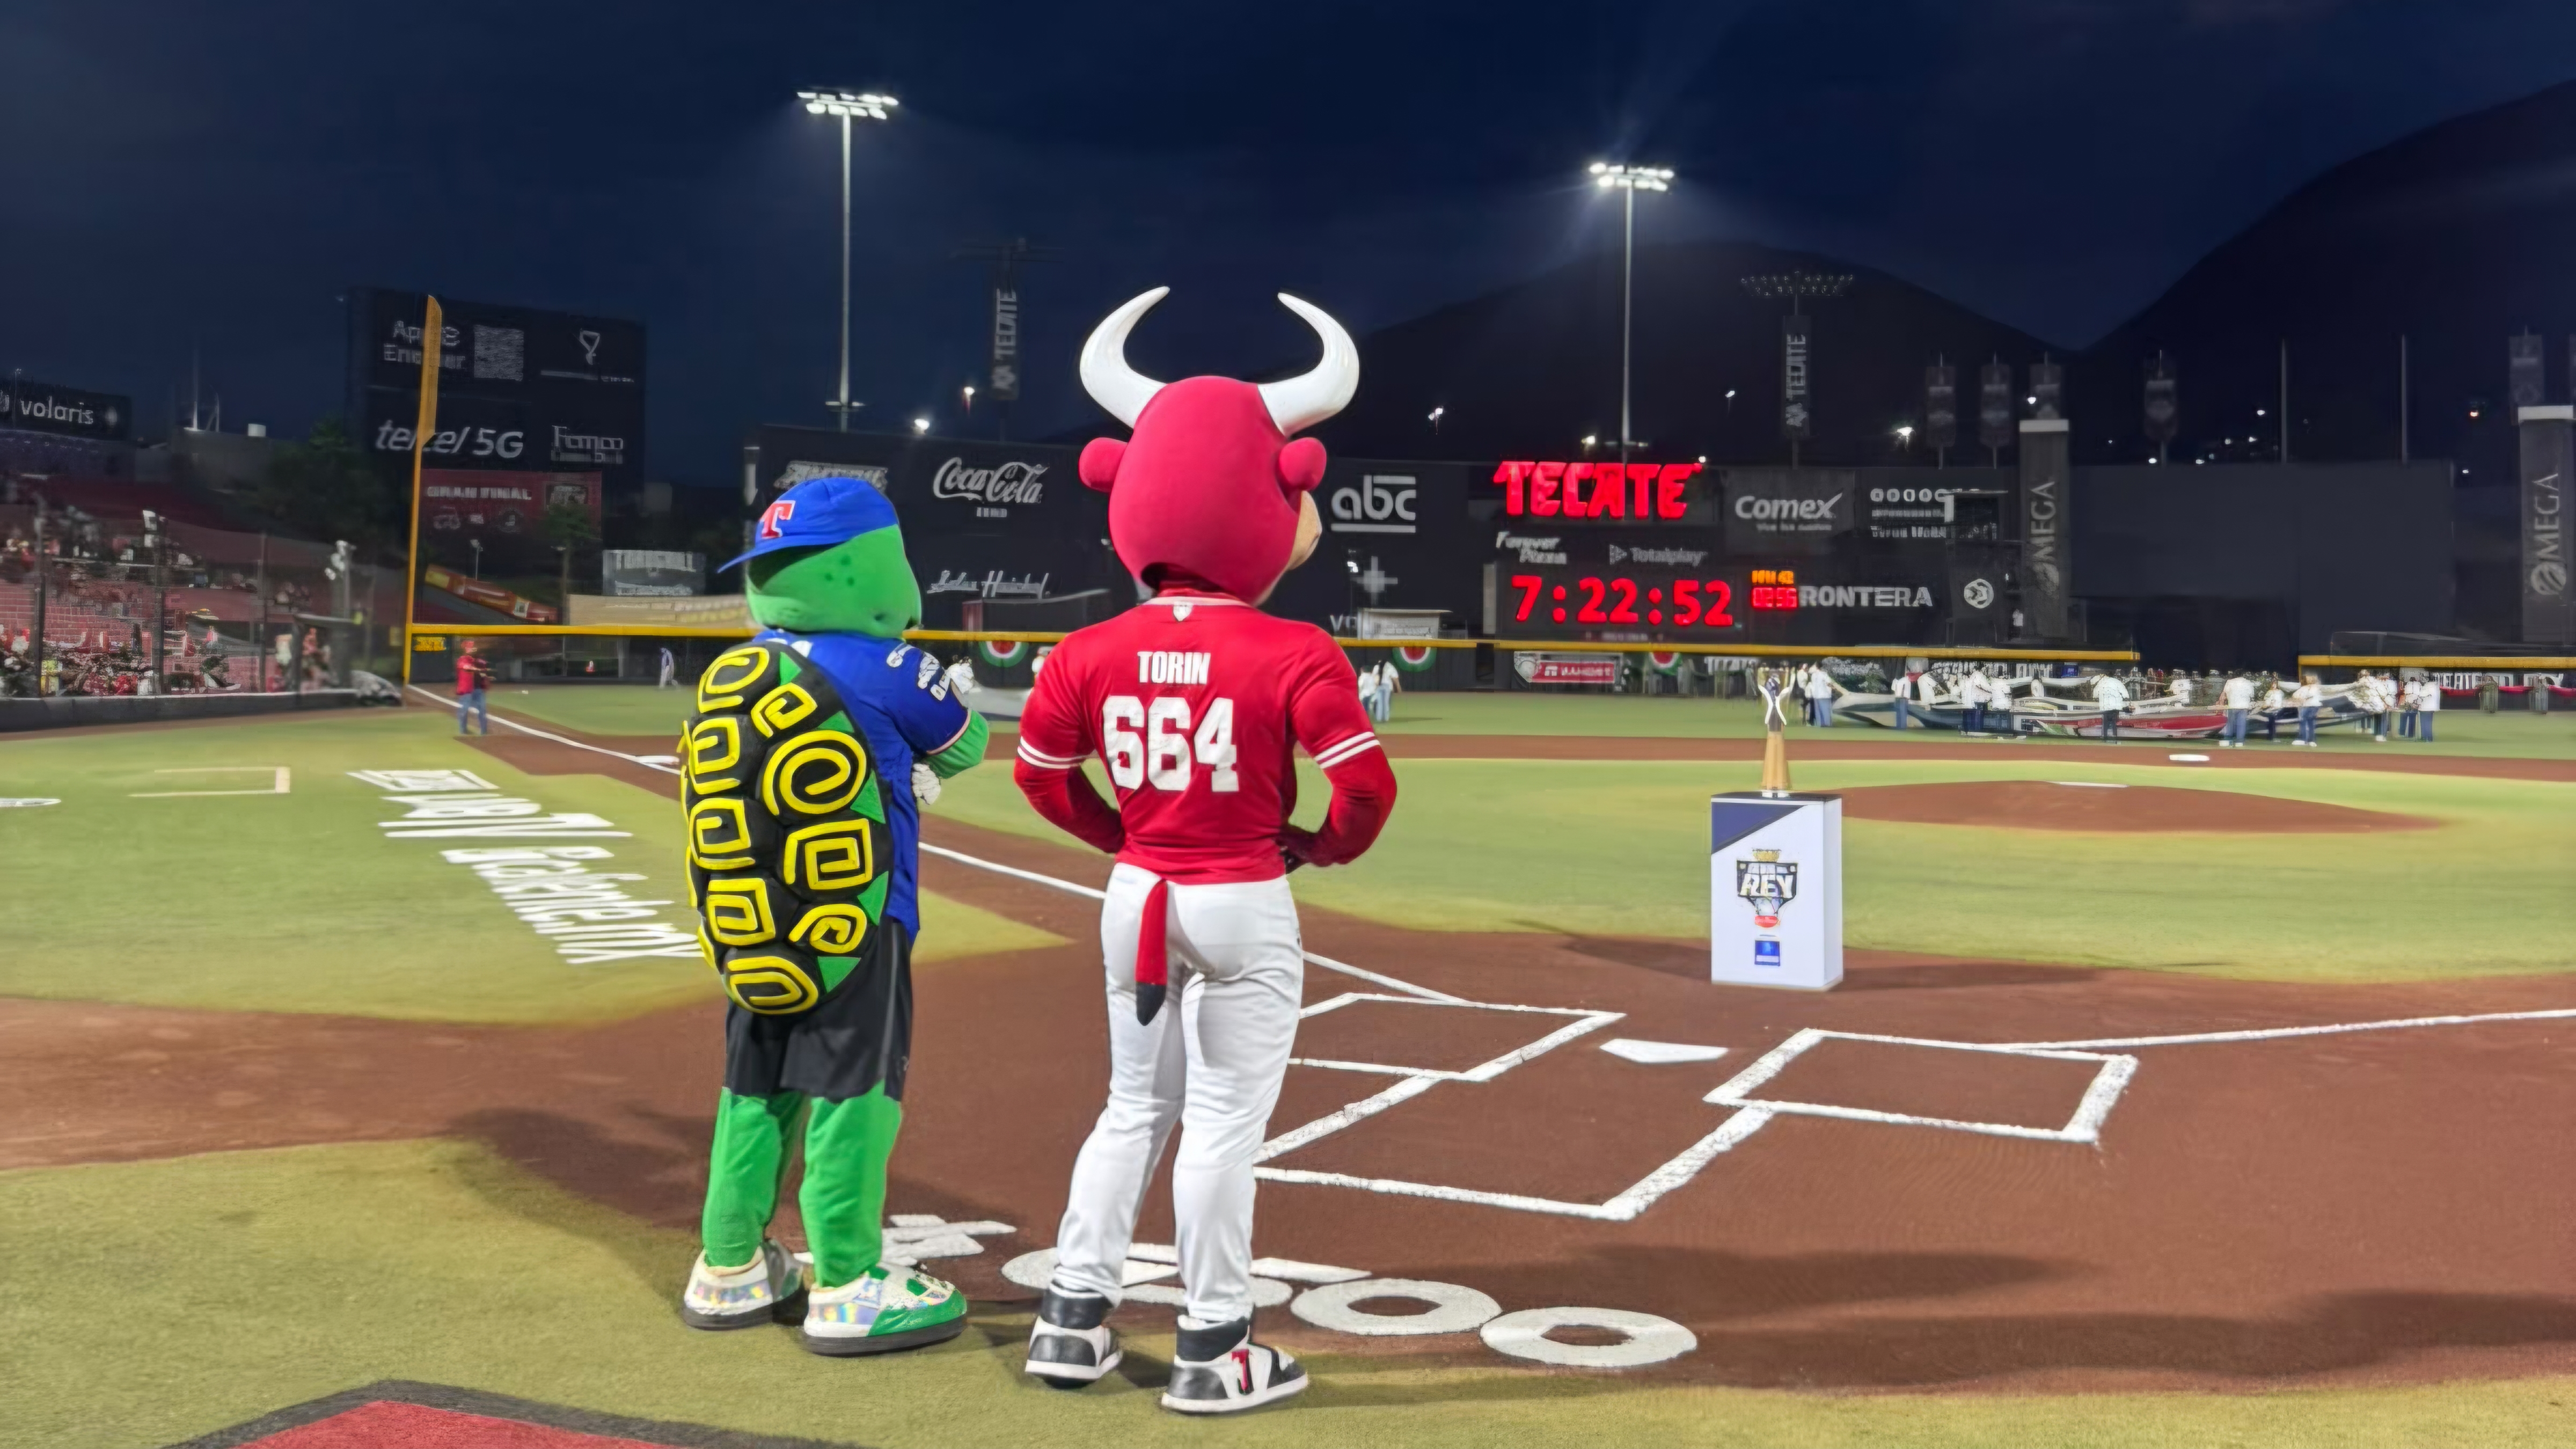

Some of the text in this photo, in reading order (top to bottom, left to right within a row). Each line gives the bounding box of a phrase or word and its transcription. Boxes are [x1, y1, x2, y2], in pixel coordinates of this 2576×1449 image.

[20, 395, 94, 425] volaris
[472, 428, 524, 459] 5G
[1331, 475, 1417, 521] abc
[1493, 461, 1703, 519] TECATE
[1735, 492, 1842, 519] Comex
[758, 499, 796, 539] T
[1511, 575, 1733, 626] 7:22:52
[1137, 651, 1211, 684] TORIN
[1102, 696, 1240, 793] 664
